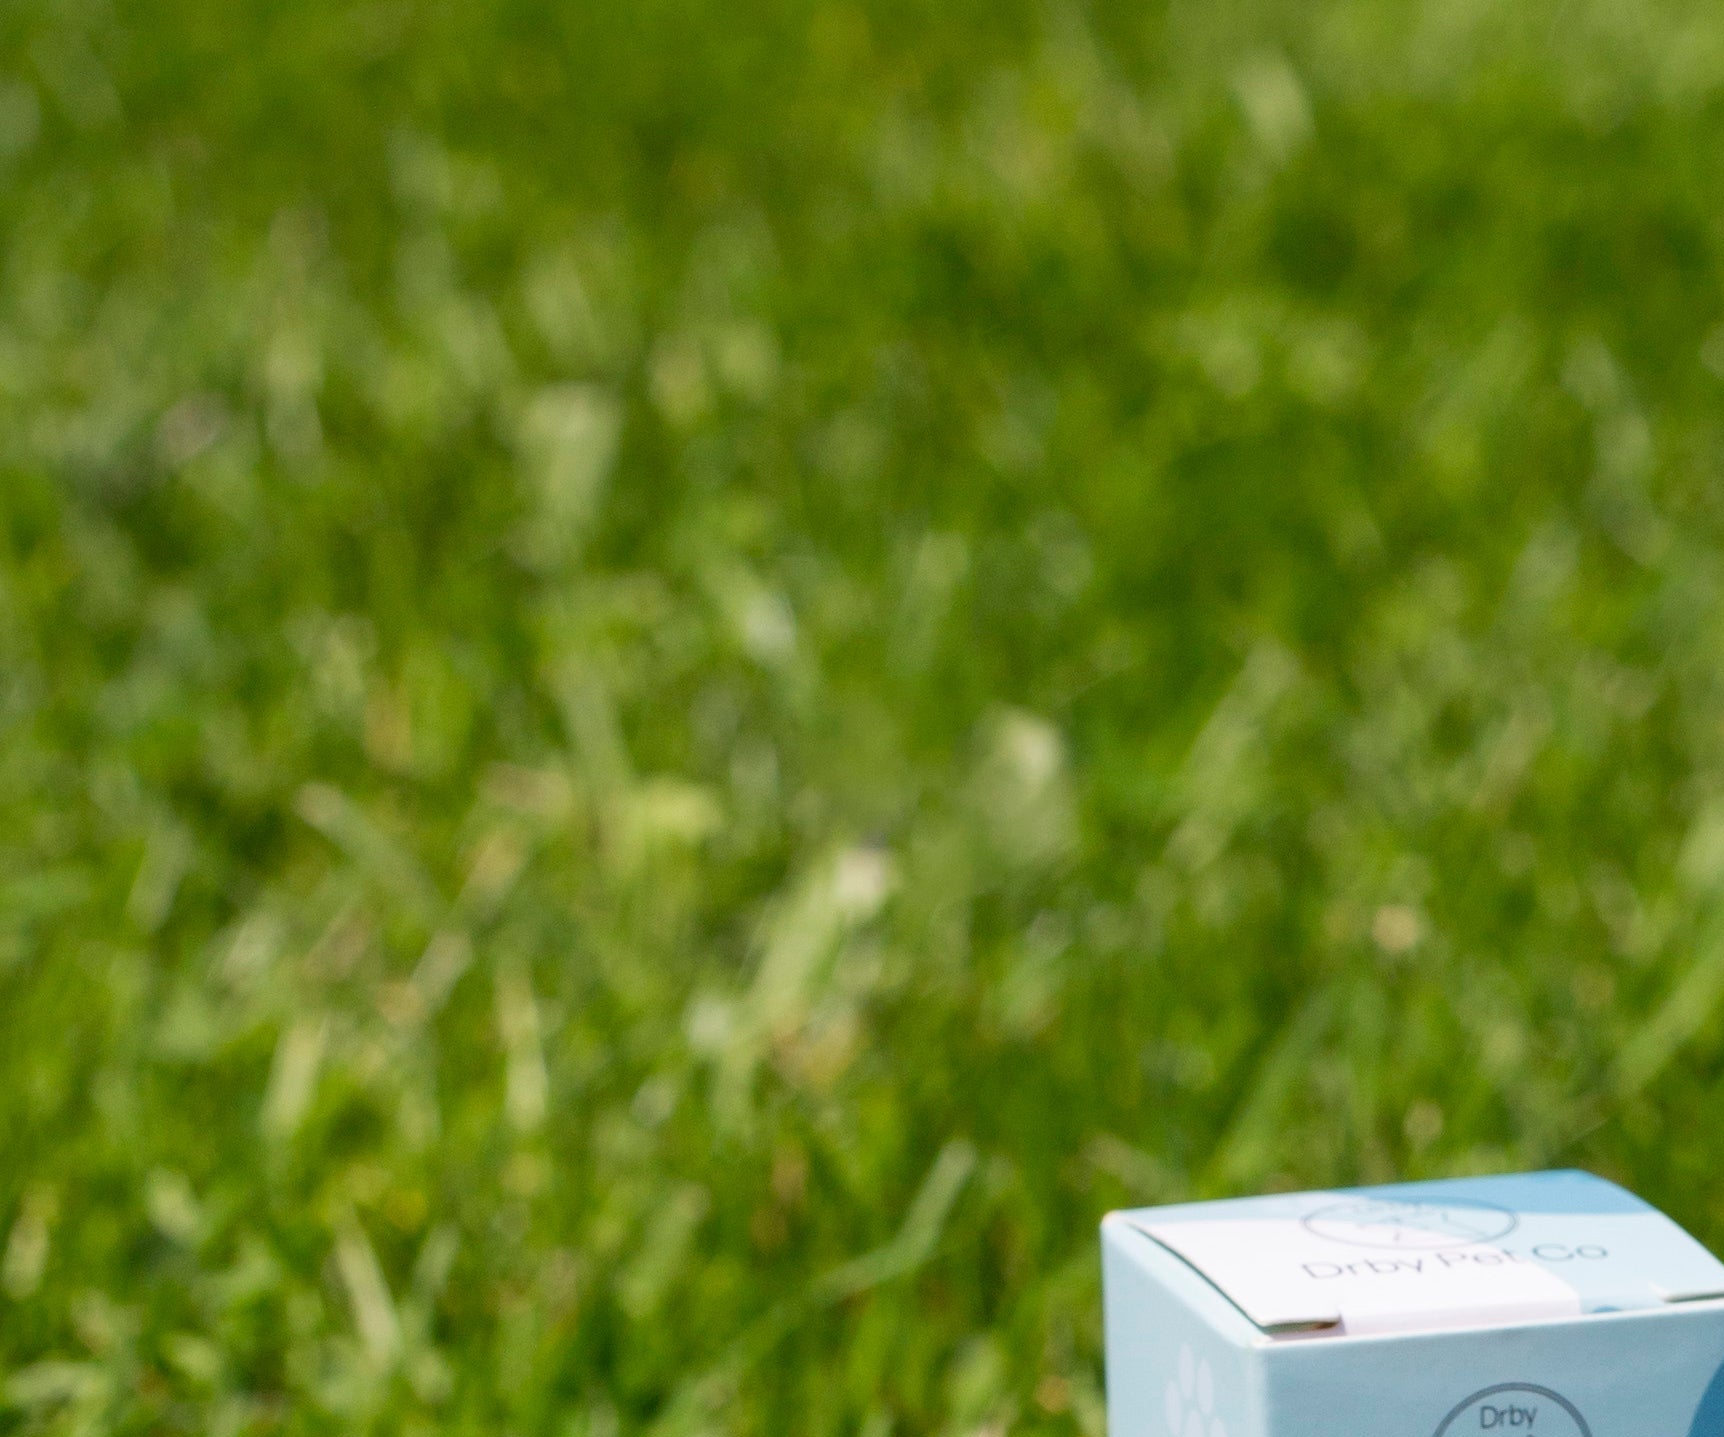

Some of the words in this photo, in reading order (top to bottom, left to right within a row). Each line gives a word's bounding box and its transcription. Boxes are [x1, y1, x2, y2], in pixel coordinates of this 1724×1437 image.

[1299, 1255, 1423, 1281] Drby
[1434, 1247, 1516, 1270] Pet
[1530, 1242, 1609, 1263] Co
[1479, 1404, 1538, 1430] Drby
